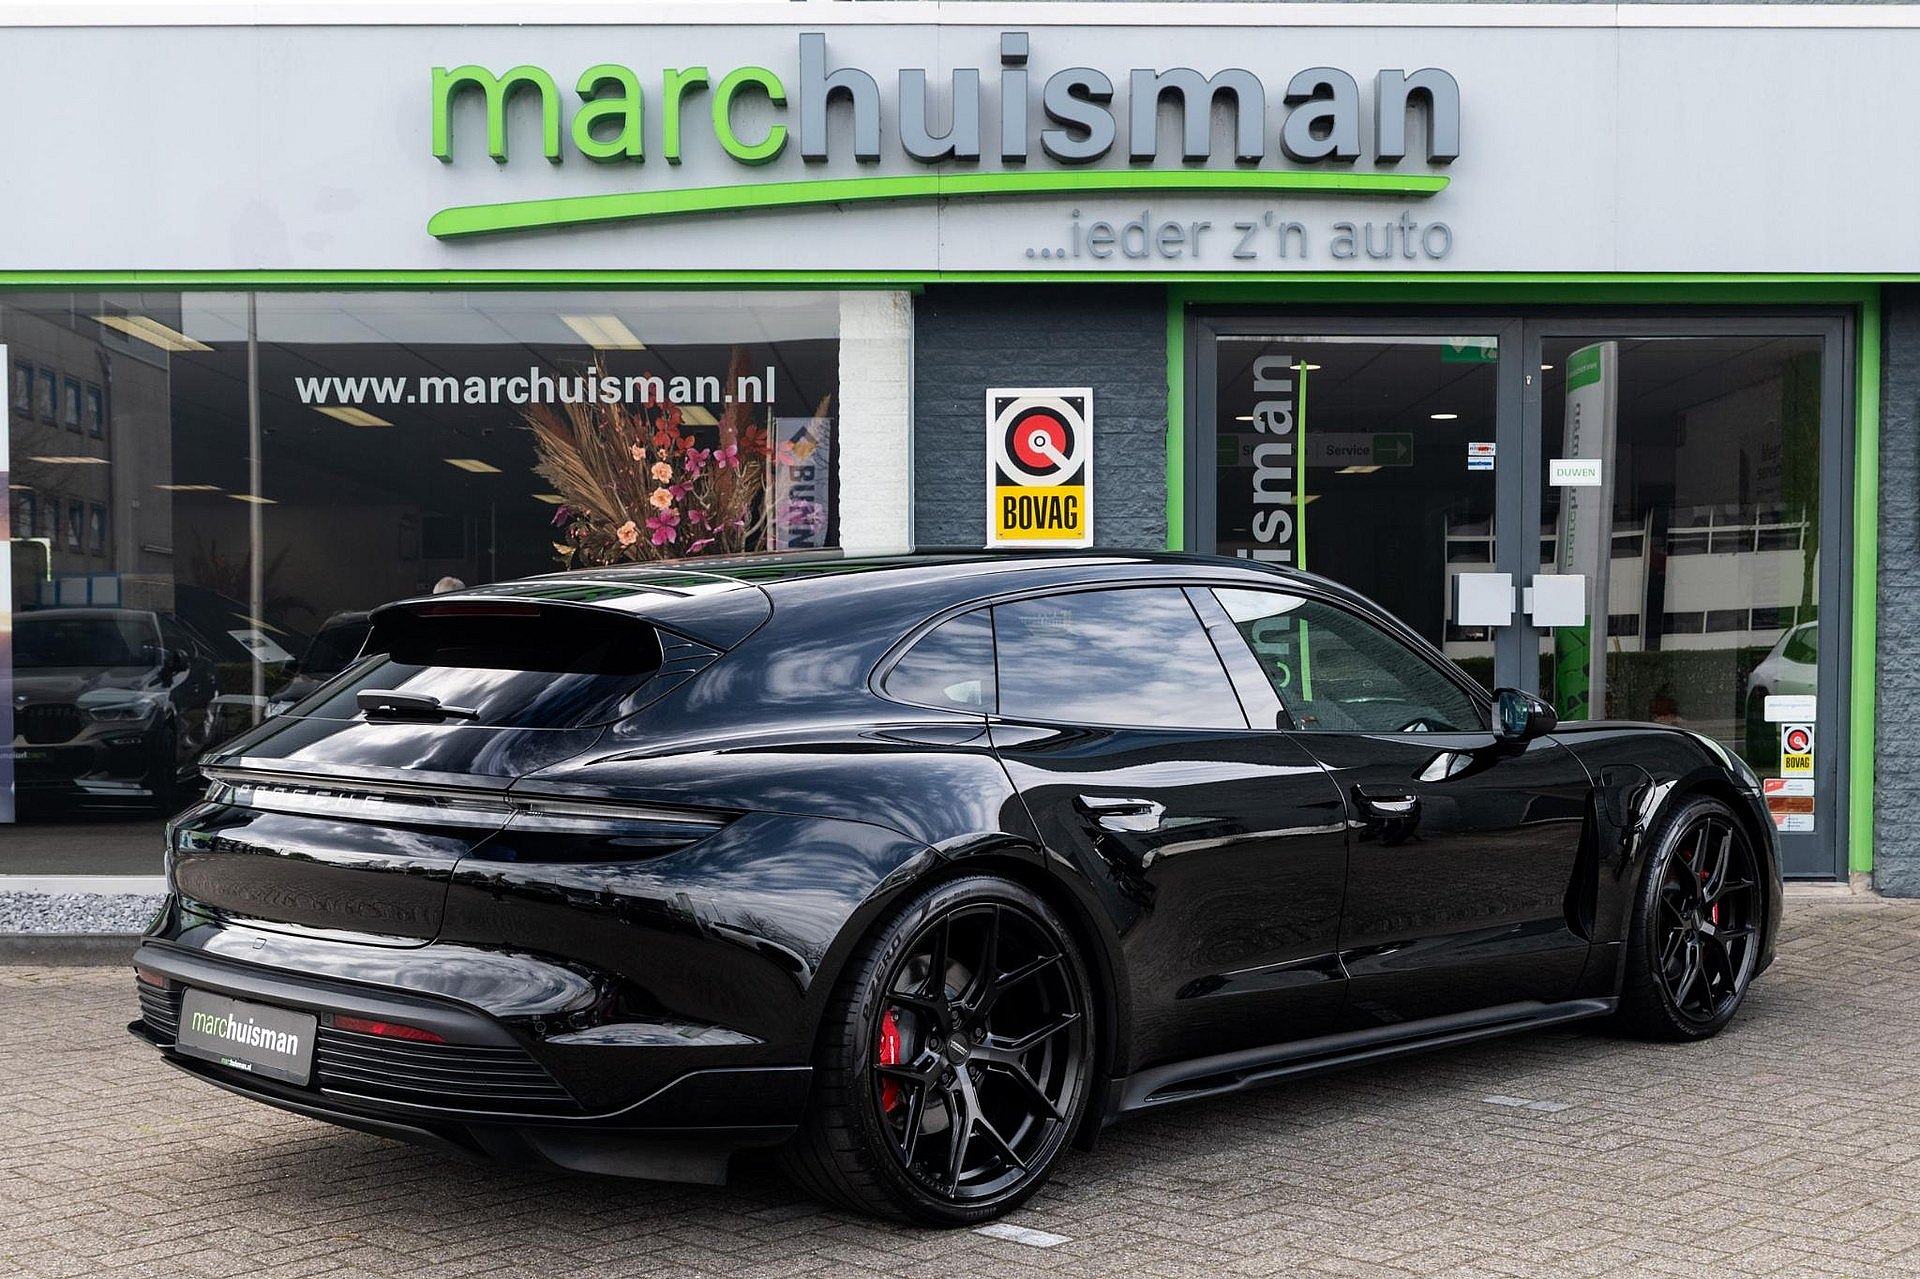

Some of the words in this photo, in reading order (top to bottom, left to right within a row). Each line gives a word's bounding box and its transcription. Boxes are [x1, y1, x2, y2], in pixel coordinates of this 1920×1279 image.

[431, 32, 1460, 165] marchuisman
[1025, 209, 1210, 259] ...ieder
[1233, 210, 1307, 259] z'n
[1330, 213, 1453, 259] auto
[295, 366, 775, 404] www.marchuisman.nl
[1557, 468, 1596, 477] DUWEN
[1003, 495, 1078, 530] BOVAG
[1785, 757, 1810, 769] BOVAG
[191, 1012, 299, 1056] marchuisman
